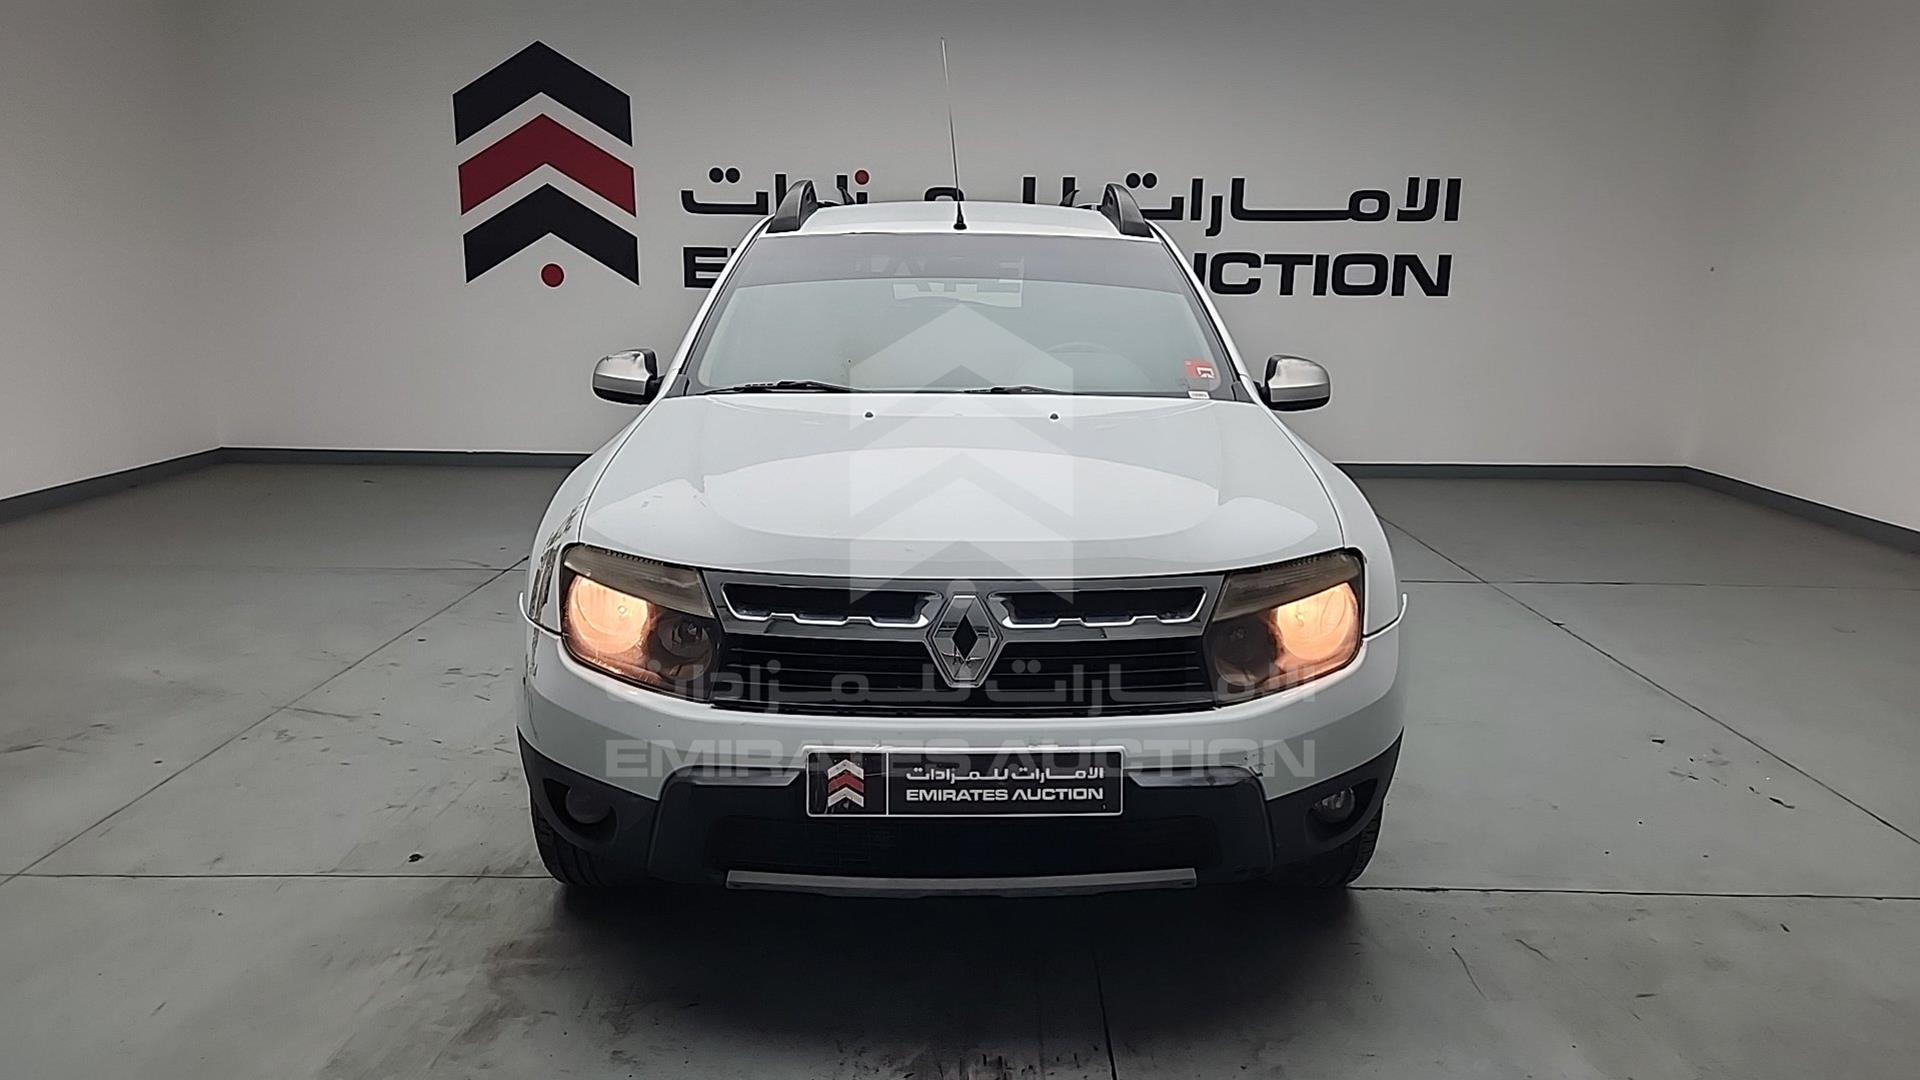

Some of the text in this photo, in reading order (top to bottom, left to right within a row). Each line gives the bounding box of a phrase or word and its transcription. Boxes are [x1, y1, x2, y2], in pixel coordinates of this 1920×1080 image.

[1194, 252, 1452, 296] CTION
[906, 788, 1104, 801] EMIRATES AUCTION
